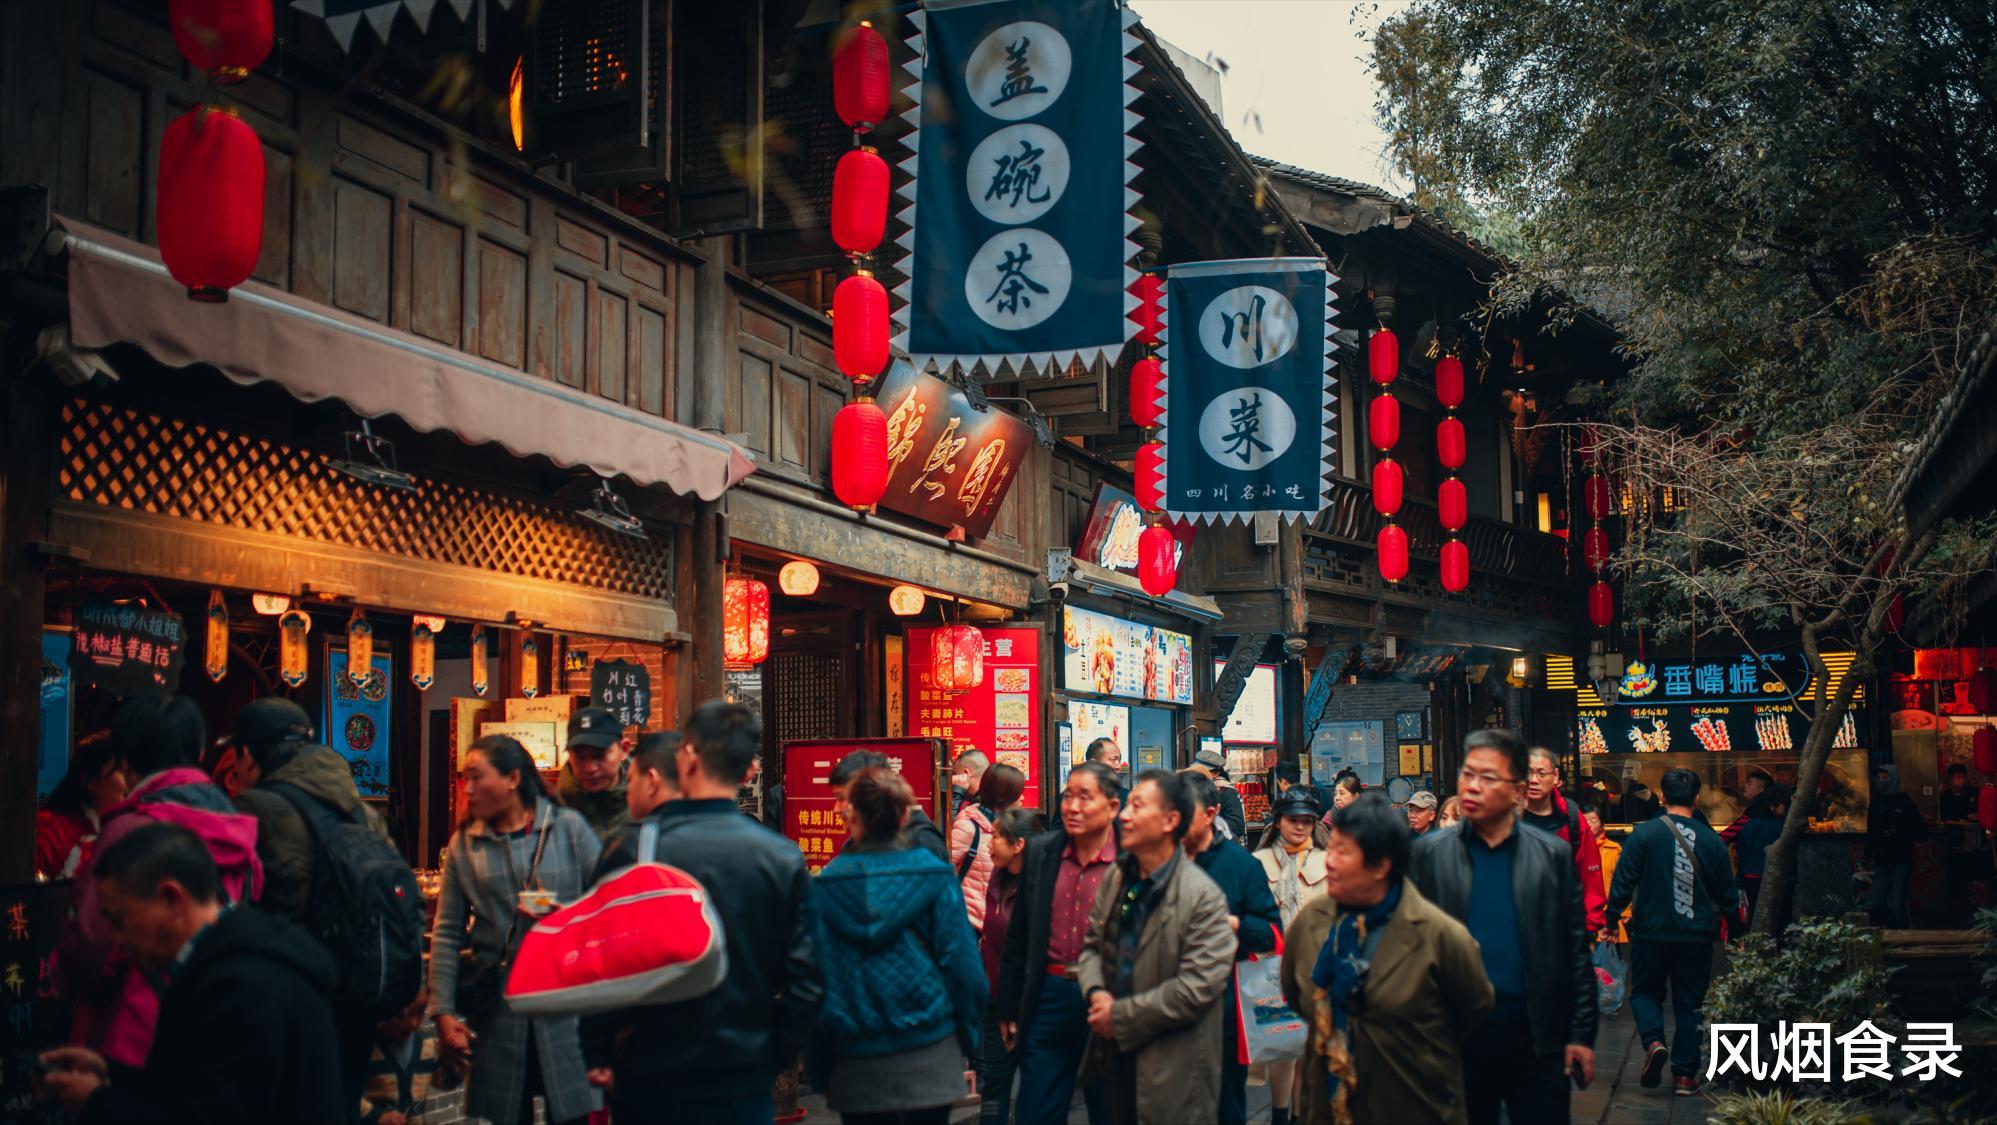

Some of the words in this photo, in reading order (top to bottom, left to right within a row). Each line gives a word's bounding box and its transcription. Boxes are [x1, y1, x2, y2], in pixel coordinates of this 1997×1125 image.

[984, 36, 1052, 316] 盖碗茶
[1220, 294, 1275, 462] 川菜
[1185, 482, 1306, 502] 四川名小吃
